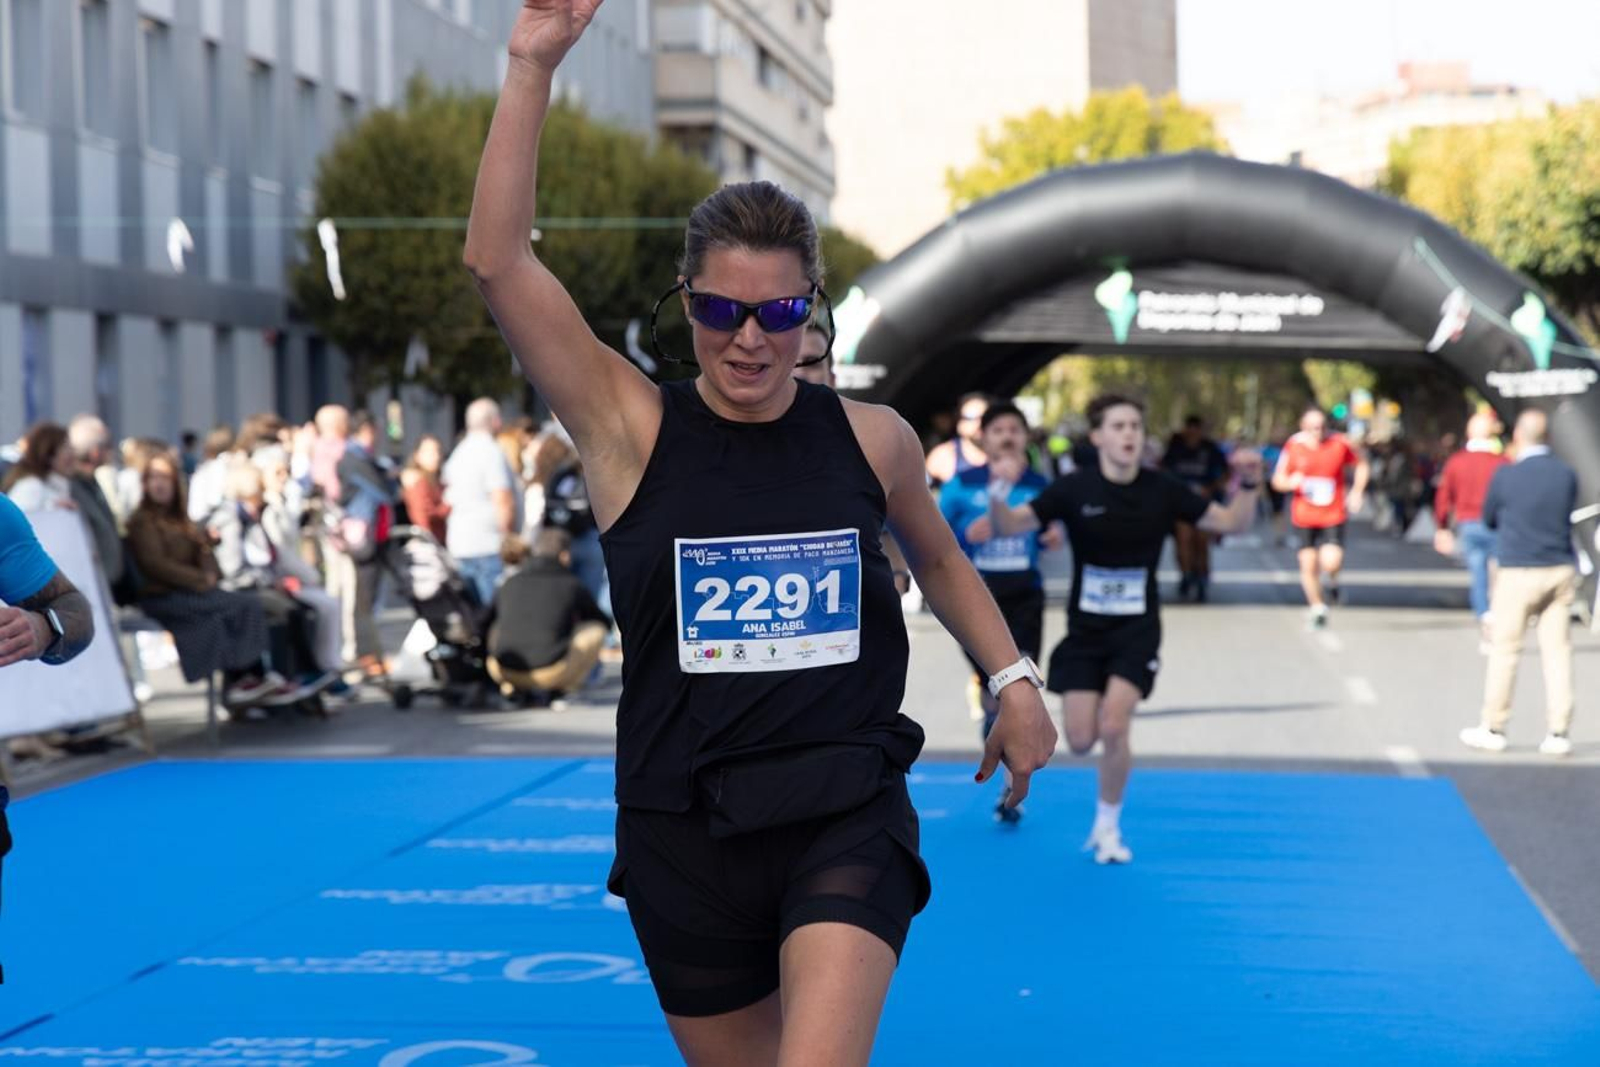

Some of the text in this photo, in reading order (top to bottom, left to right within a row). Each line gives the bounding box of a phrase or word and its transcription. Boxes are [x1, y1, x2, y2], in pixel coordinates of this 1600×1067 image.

[694, 569, 840, 622] 2291
[742, 620, 806, 634] ANA ISABEL
